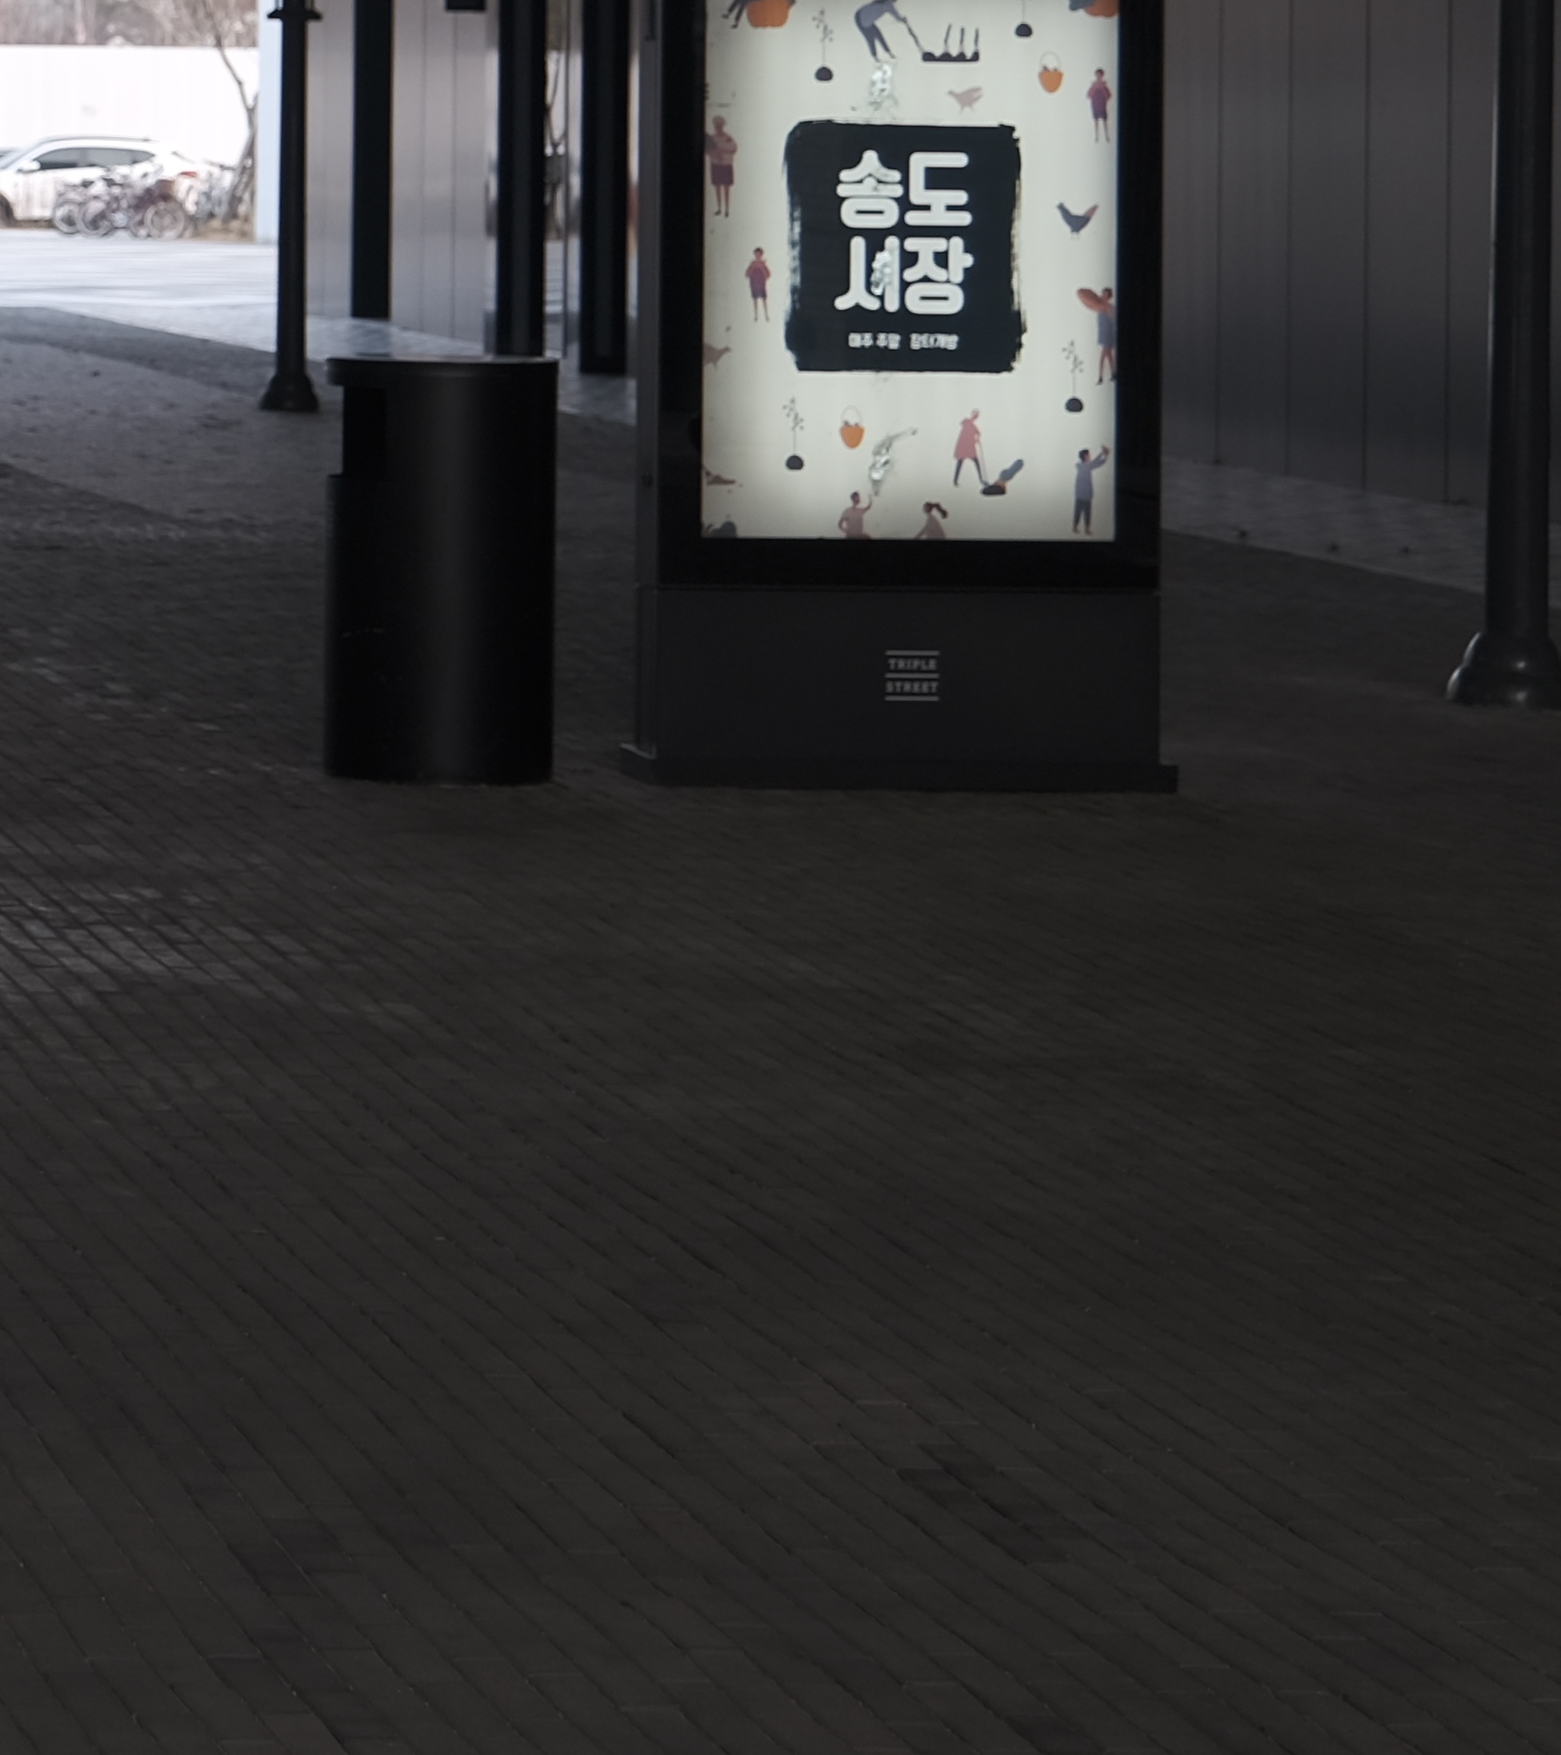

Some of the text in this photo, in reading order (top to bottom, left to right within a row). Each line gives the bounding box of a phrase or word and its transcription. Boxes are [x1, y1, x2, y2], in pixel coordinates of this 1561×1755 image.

[835, 148, 973, 229] 송도
[887, 657, 938, 671] TRIPLE
[884, 680, 939, 694] STREET
